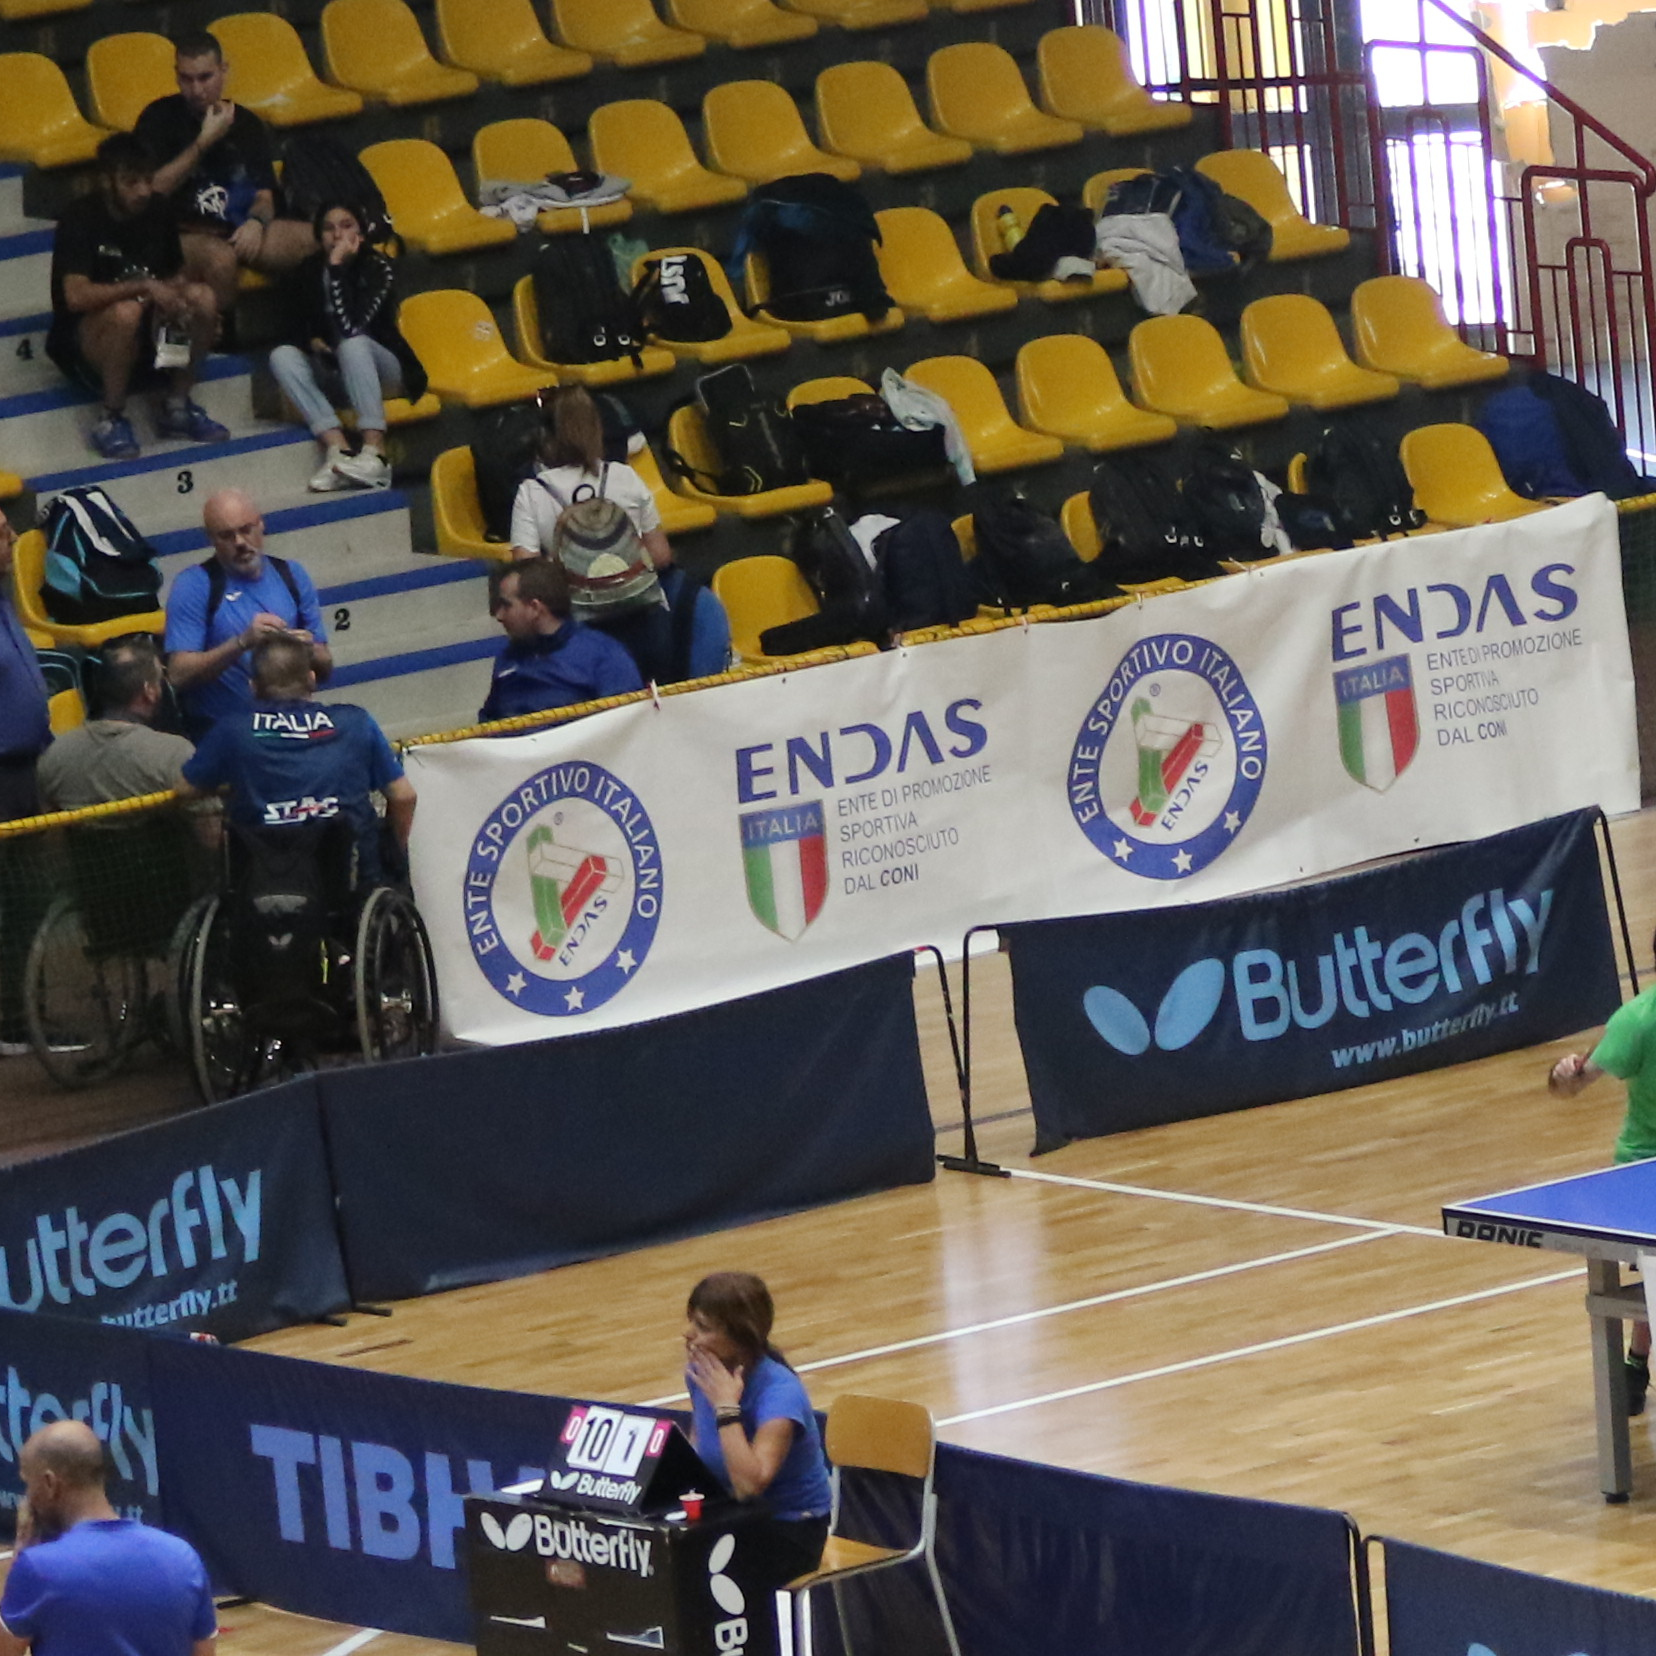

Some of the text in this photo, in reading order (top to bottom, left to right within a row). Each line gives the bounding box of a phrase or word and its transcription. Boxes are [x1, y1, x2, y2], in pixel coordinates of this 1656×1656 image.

[16, 339, 33, 360] 4
[177, 471, 194, 494] 3
[335, 608, 351, 631] 2
[1331, 563, 1579, 662] ENDAS
[1427, 628, 1583, 670] ENTE PROMOZIONE
[1341, 668, 1405, 696] ITALIA
[1430, 670, 1500, 695] SPORTIVA
[253, 712, 334, 731] ITALIA
[1433, 688, 1540, 720] RICONOSCIUTO
[735, 697, 990, 805] ENDAS
[1078, 640, 1263, 823] ENTE SPORTIVO ITALIANO
[1437, 721, 1508, 747] DAL CONI
[837, 764, 992, 818] ENTE PROMOZIONE
[1161, 761, 1209, 831] ENDAS
[747, 811, 819, 838] ITALIA
[840, 813, 919, 842] SPORTIVA
[465, 769, 659, 954] ENTE SPORTIVO ITALIANO
[842, 827, 959, 869] RICONOSCIUTO
[844, 864, 919, 895] DAL CONI
[559, 896, 609, 967] ENDAS
[1233, 889, 1553, 1042] Butterfly
[1332, 991, 1520, 1069] www.butterfly.tt
[0, 1165, 261, 1312] utterfly
[1457, 1220, 1543, 1249] DONIC
[566, 1416, 665, 1464] 0 10 1 0
[577, 1473, 641, 1505] Butterfly
[534, 1514, 654, 1577] Butterfly
